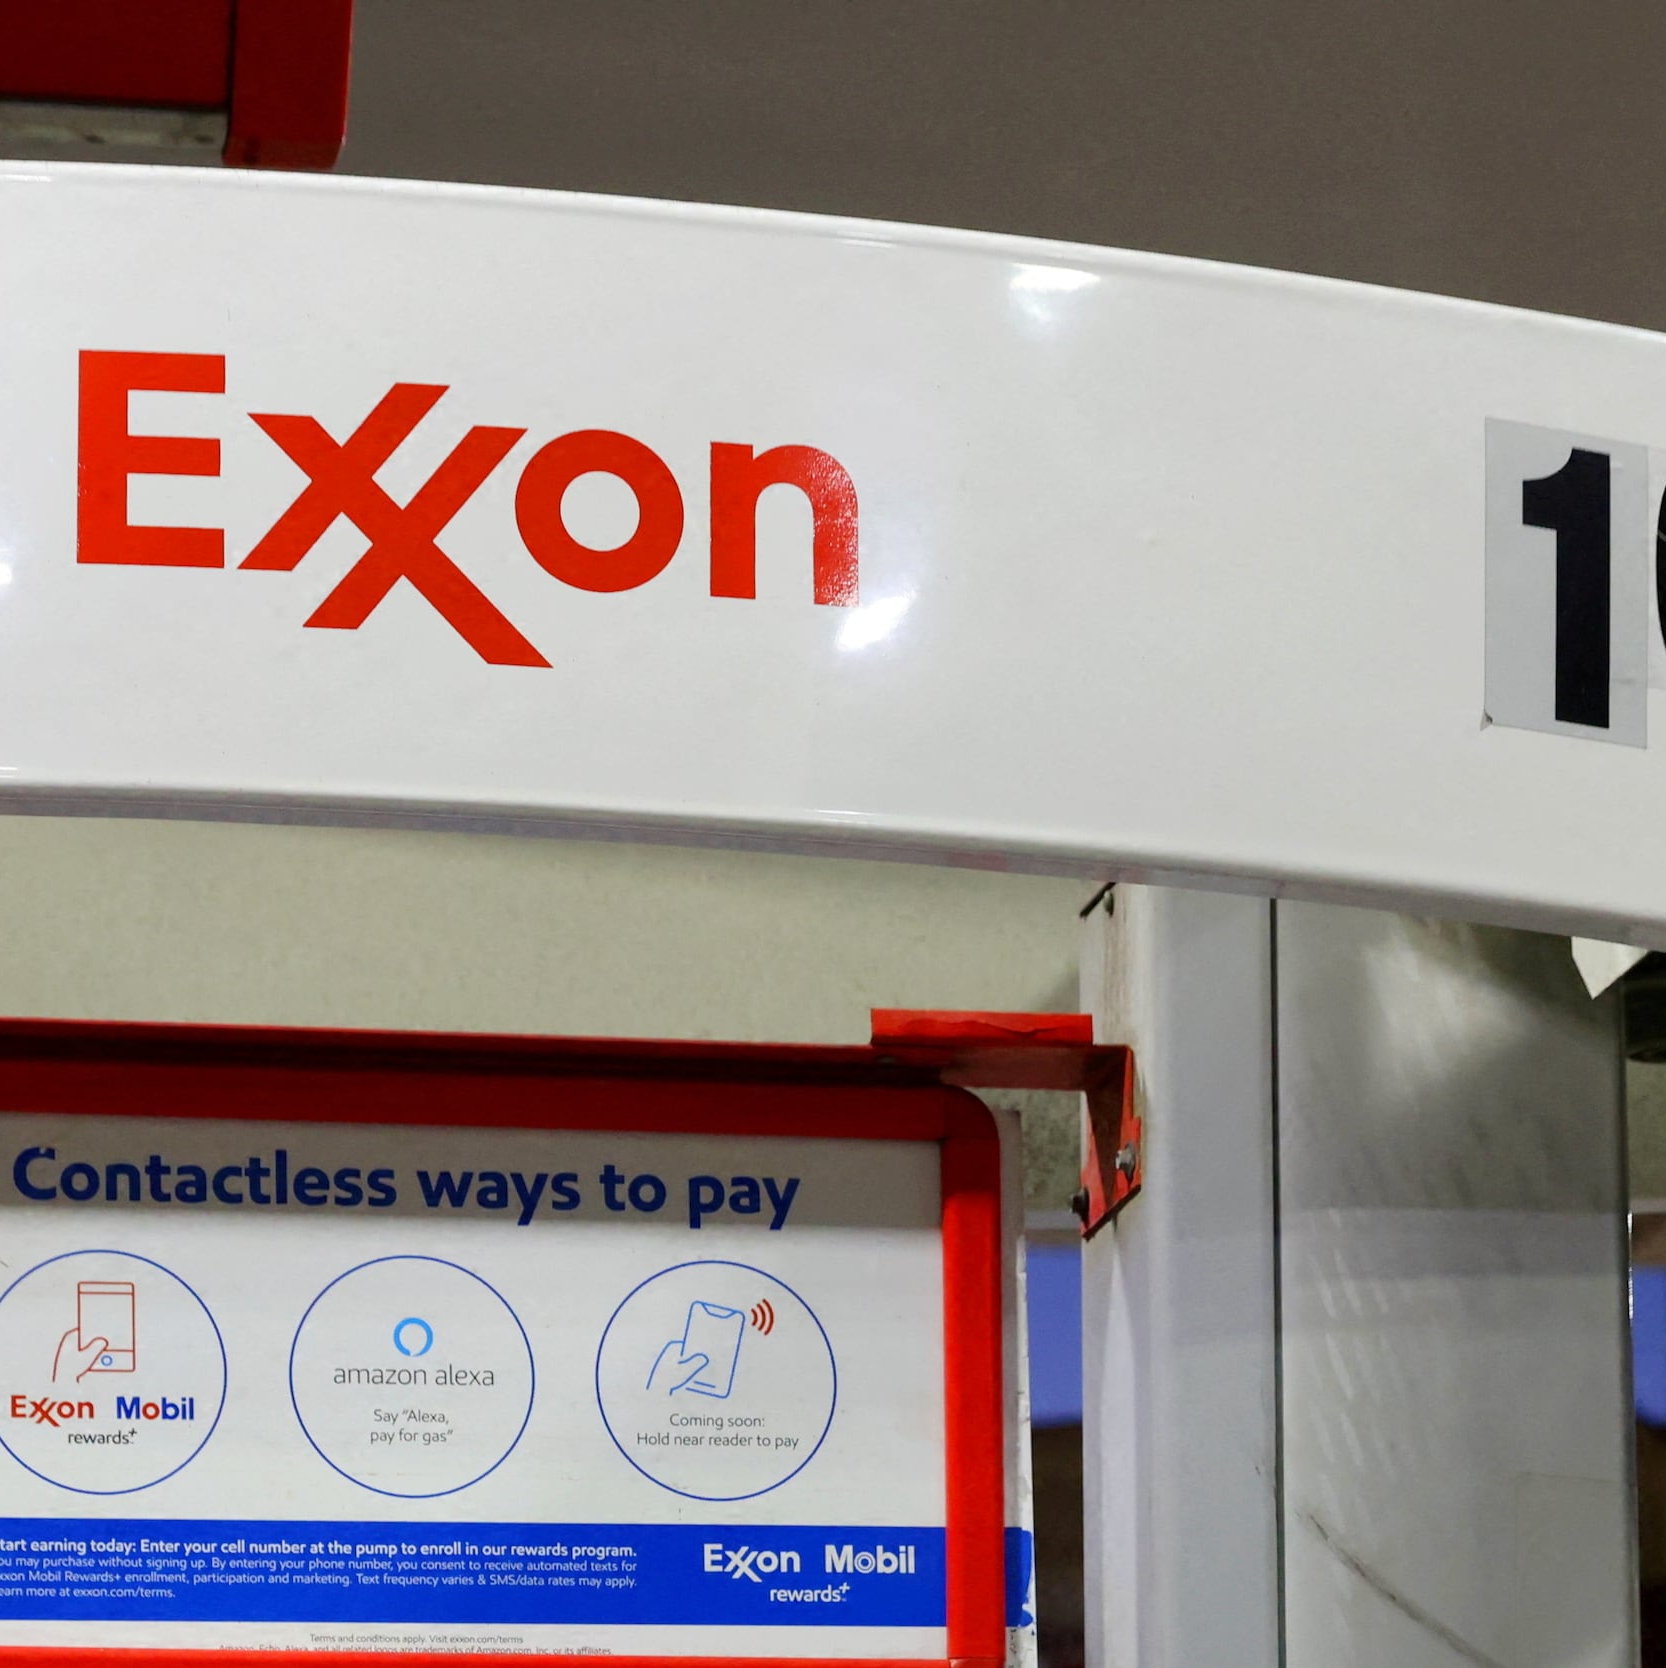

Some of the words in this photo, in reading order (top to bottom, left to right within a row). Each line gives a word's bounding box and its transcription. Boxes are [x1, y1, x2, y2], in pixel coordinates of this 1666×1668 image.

[77, 350, 860, 668] Exxon
[13, 1147, 397, 1207] Contactless
[418, 1165, 580, 1226] ways
[600, 1165, 666, 1212] to
[688, 1175, 800, 1230] pay
[334, 1369, 426, 1385] amazon
[436, 1364, 494, 1385] alexa
[11, 1395, 94, 1427] Exxon
[117, 1397, 194, 1420] Mobil
[374, 1409, 398, 1424] Say
[670, 1414, 723, 1430] Coming
[728, 1418, 764, 1427] soon:
[371, 1432, 394, 1445] pay
[399, 1428, 418, 1441] for
[638, 1433, 669, 1445] Hold
[674, 1436, 704, 1445] near
[709, 1434, 752, 1446] reader
[757, 1436, 771, 1446] to
[775, 1438, 799, 1449] pay
[31, 1538, 86, 1555] earning
[90, 1539, 136, 1555] today:
[141, 1539, 180, 1552] Enter
[184, 1543, 217, 1556] your
[220, 1539, 246, 1552] cell
[250, 1540, 306, 1553] number
[310, 1542, 324, 1553] at
[328, 1541, 352, 1553] the
[355, 1545, 397, 1557] pump
[401, 1543, 416, 1554] to
[421, 1542, 461, 1554] enroll
[466, 1542, 478, 1554] in
[483, 1546, 506, 1554] our
[511, 1543, 568, 1555] rewards
[572, 1547, 636, 1559] program.
[16, 1559, 39, 1568] may
[43, 1557, 95, 1569] purchase
[98, 1557, 142, 1567] without
[146, 1559, 187, 1570] signing
[191, 1561, 207, 1570] up.
[212, 1558, 226, 1570] By
[229, 1559, 276, 1571] entering
[280, 1561, 304, 1570] your
[309, 1559, 345, 1571] phone
[349, 1559, 393, 1570] number,
[397, 1562, 417, 1572] you
[421, 1561, 465, 1569] consent
[469, 1561, 481, 1570] to
[485, 1562, 523, 1570] receive
[527, 1561, 587, 1570] automated
[622, 1560, 637, 1570] for
[704, 1544, 800, 1582] Exxon
[825, 1545, 915, 1573] Mobil
[28, 1571, 61, 1581] Mobil
[65, 1572, 120, 1581] Rewards+
[125, 1572, 189, 1583] enrollment,
[194, 1573, 264, 1585] participation
[268, 1573, 289, 1583] and
[293, 1573, 349, 1587] marketing.
[357, 1573, 379, 1584] Text
[384, 1574, 438, 1587] frequency
[442, 1575, 473, 1584] varies
[478, 1575, 485, 1584] &
[490, 1575, 544, 1585] SMS/data
[548, 1577, 575, 1585] rates
[579, 1578, 601, 1588] may
[605, 1576, 636, 1588] apply.
[25, 1589, 56, 1597] more
[59, 1588, 70, 1596] at
[73, 1587, 175, 1597] exxon.com/terms.
